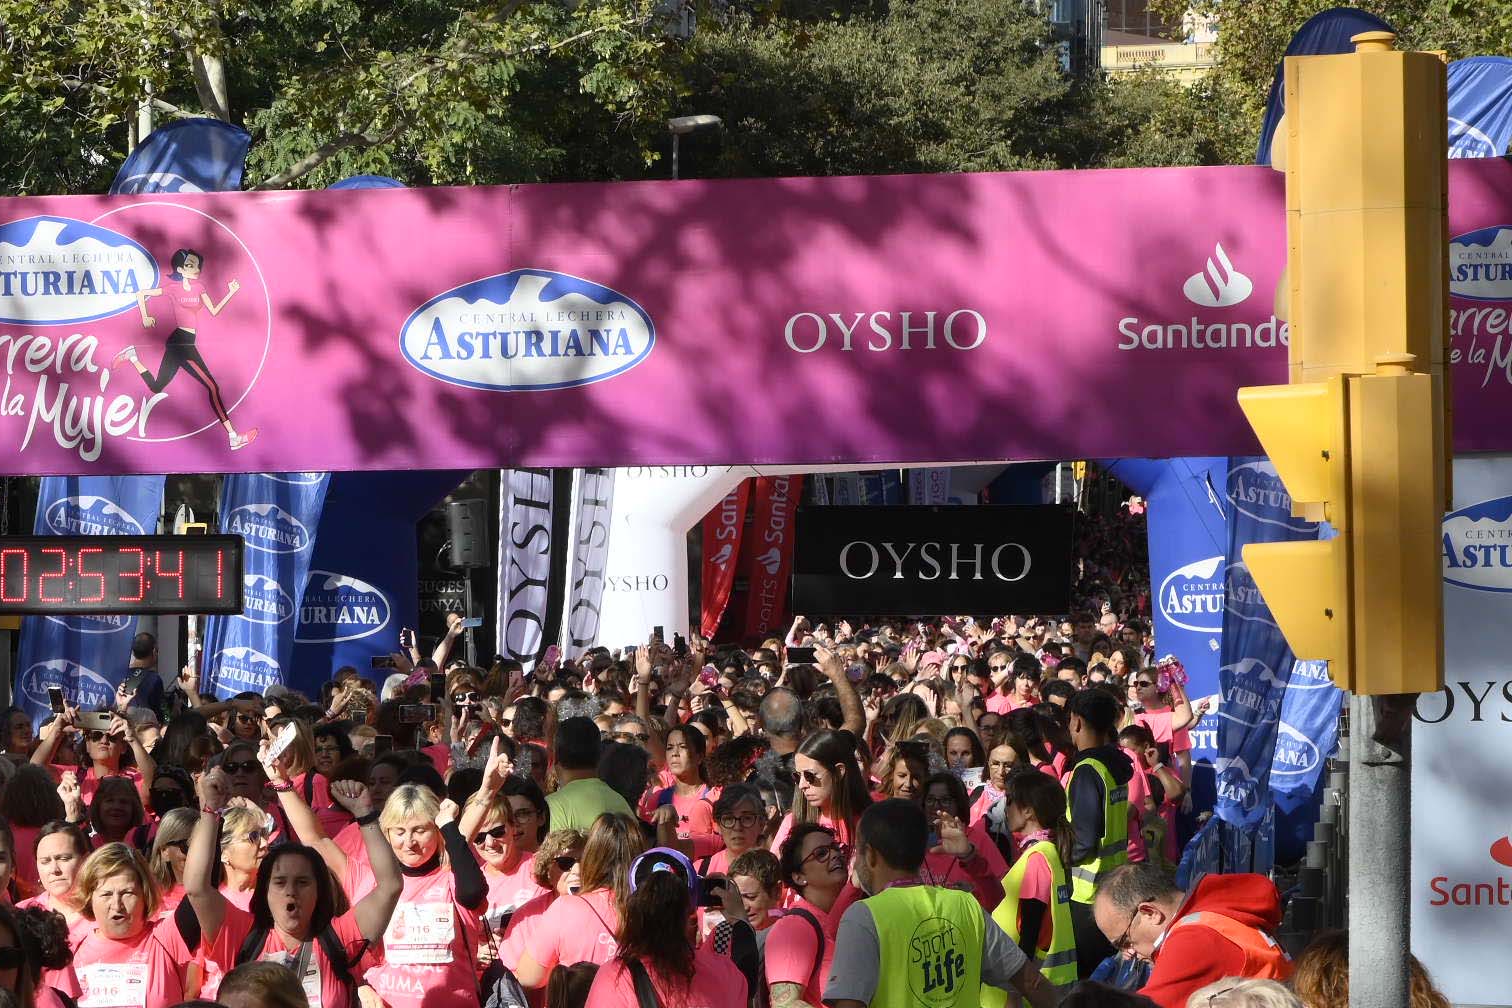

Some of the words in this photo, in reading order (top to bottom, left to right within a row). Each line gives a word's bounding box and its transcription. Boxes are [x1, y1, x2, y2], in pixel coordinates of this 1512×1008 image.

[458, 311, 538, 323] CENTRAL
[545, 309, 626, 322] LECHERA
[785, 309, 987, 353] OYSHO
[420, 315, 635, 362] ASTURIANA
[0, 375, 25, 417] la
[20, 367, 169, 463] Mujer
[764, 475, 790, 544] Santa
[0, 547, 224, 603] 02:53:41
[506, 469, 552, 663] OYSH
[571, 467, 610, 649] OYSH
[839, 540, 1032, 582] OYSHO
[602, 574, 669, 592] YSHO
[1166, 585, 1225, 614] ASTU
[1183, 583, 1225, 592] CENTRA
[300, 605, 381, 625] URIANA
[911, 926, 957, 963] Sport
[922, 948, 965, 994] Life
